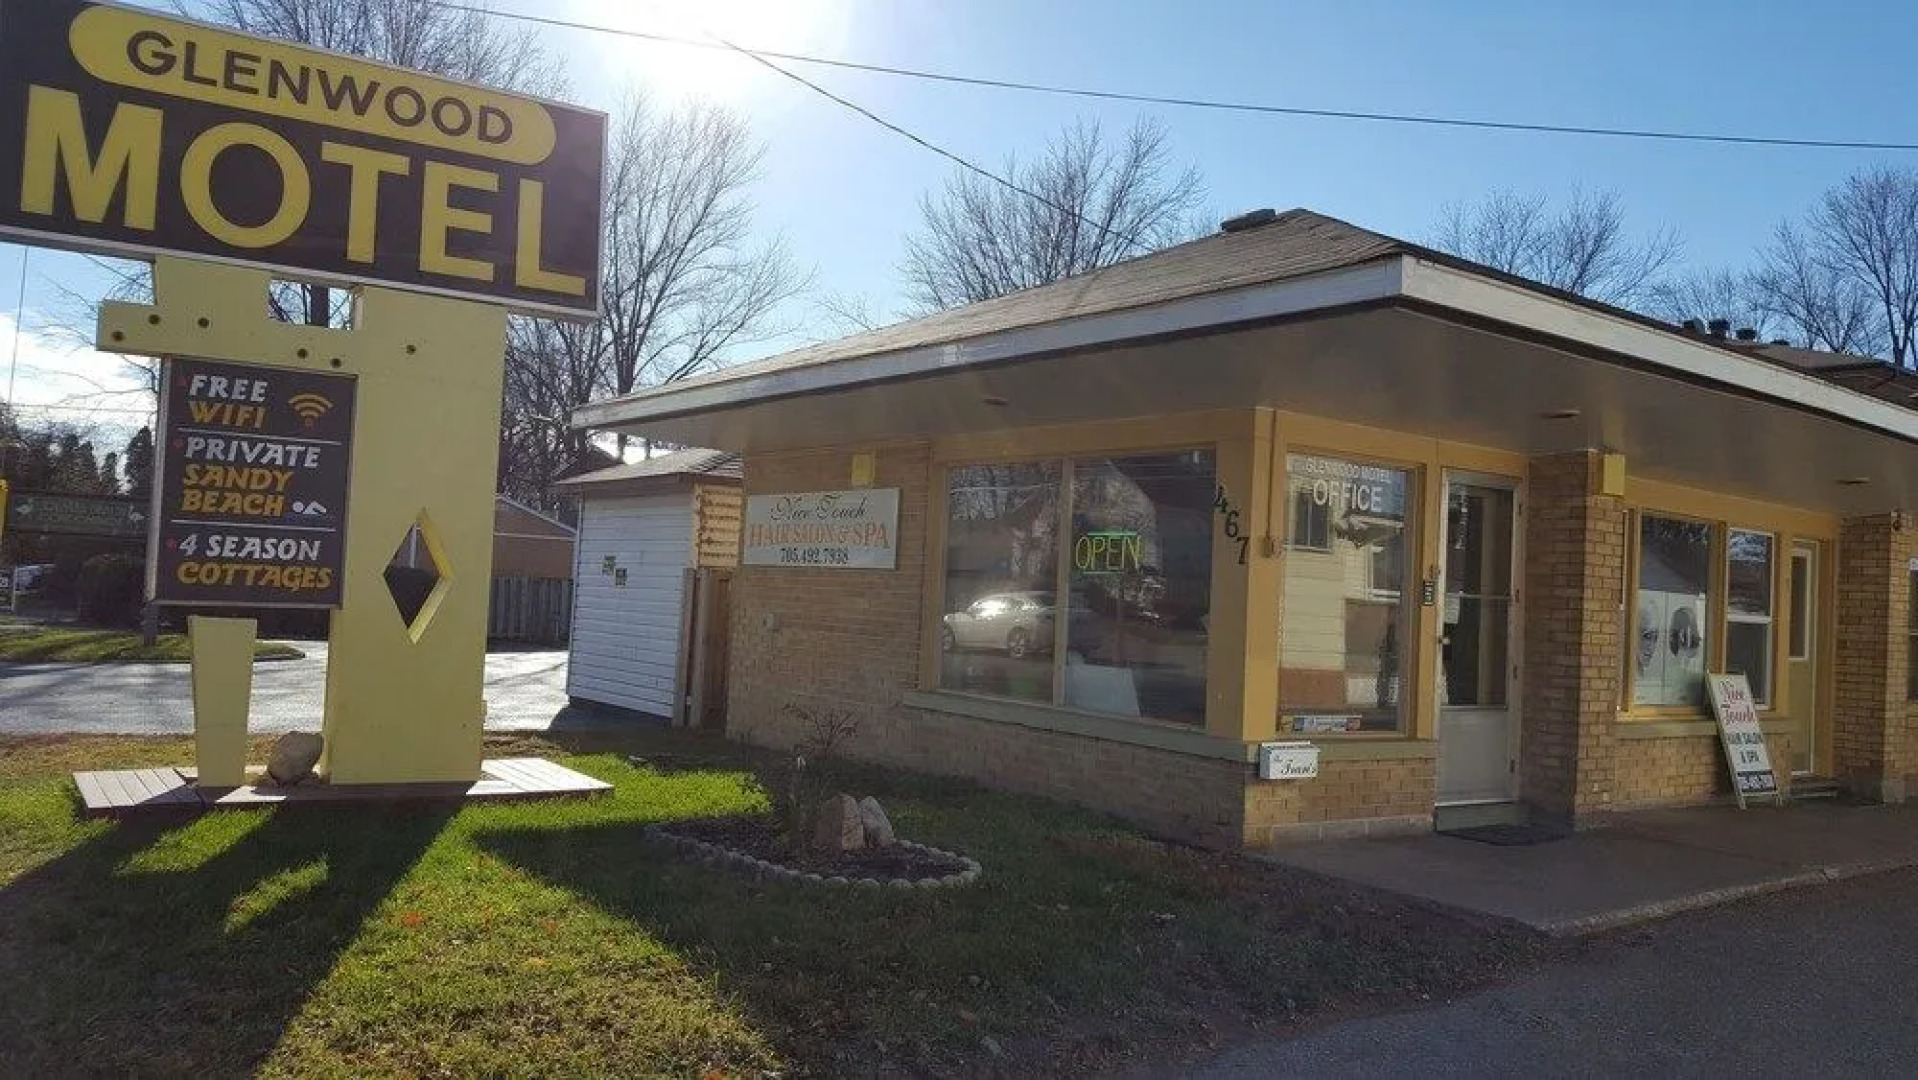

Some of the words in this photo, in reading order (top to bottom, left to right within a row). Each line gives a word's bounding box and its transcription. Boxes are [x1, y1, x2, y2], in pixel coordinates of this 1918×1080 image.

[126, 30, 513, 145] GLENWOOD
[20, 84, 586, 296] MOTEL
[189, 375, 268, 402] FREE
[189, 401, 267, 428] WIFI
[185, 436, 321, 467] PRIVATE
[183, 463, 293, 492] SANDY
[181, 488, 285, 517] BEACH
[1314, 479, 1383, 513] OFFICE
[179, 534, 199, 555] 4
[205, 534, 321, 561] SEASON
[853, 521, 891, 549] SPA
[1075, 535, 1144, 570] OPEN
[176, 561, 333, 592] COTTAGES
